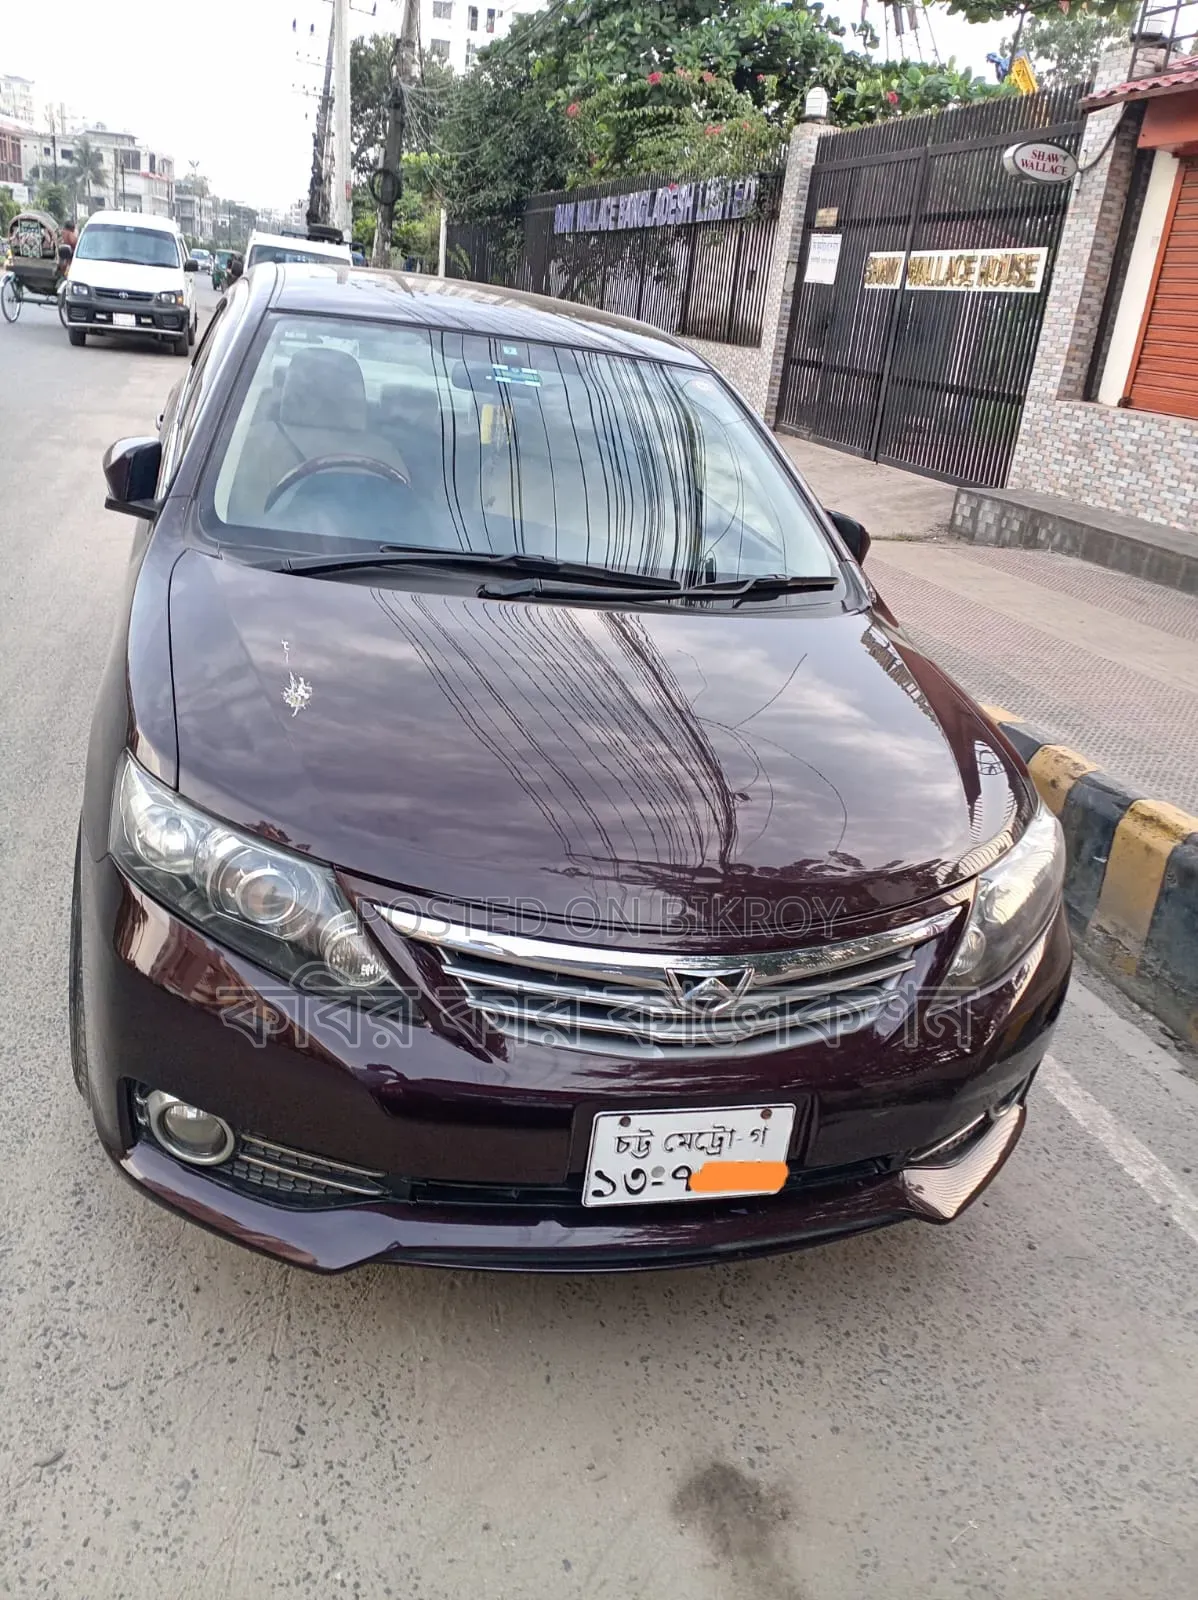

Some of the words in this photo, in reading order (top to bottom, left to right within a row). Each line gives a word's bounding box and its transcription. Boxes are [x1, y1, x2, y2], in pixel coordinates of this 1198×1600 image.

[1020, 158, 1068, 177] WALLACE
[1031, 149, 1060, 163] SHAW
[618, 182, 696, 230] BANGLADESH
[907, 254, 977, 288] WALLACE
[976, 252, 1041, 289] HOUSE
